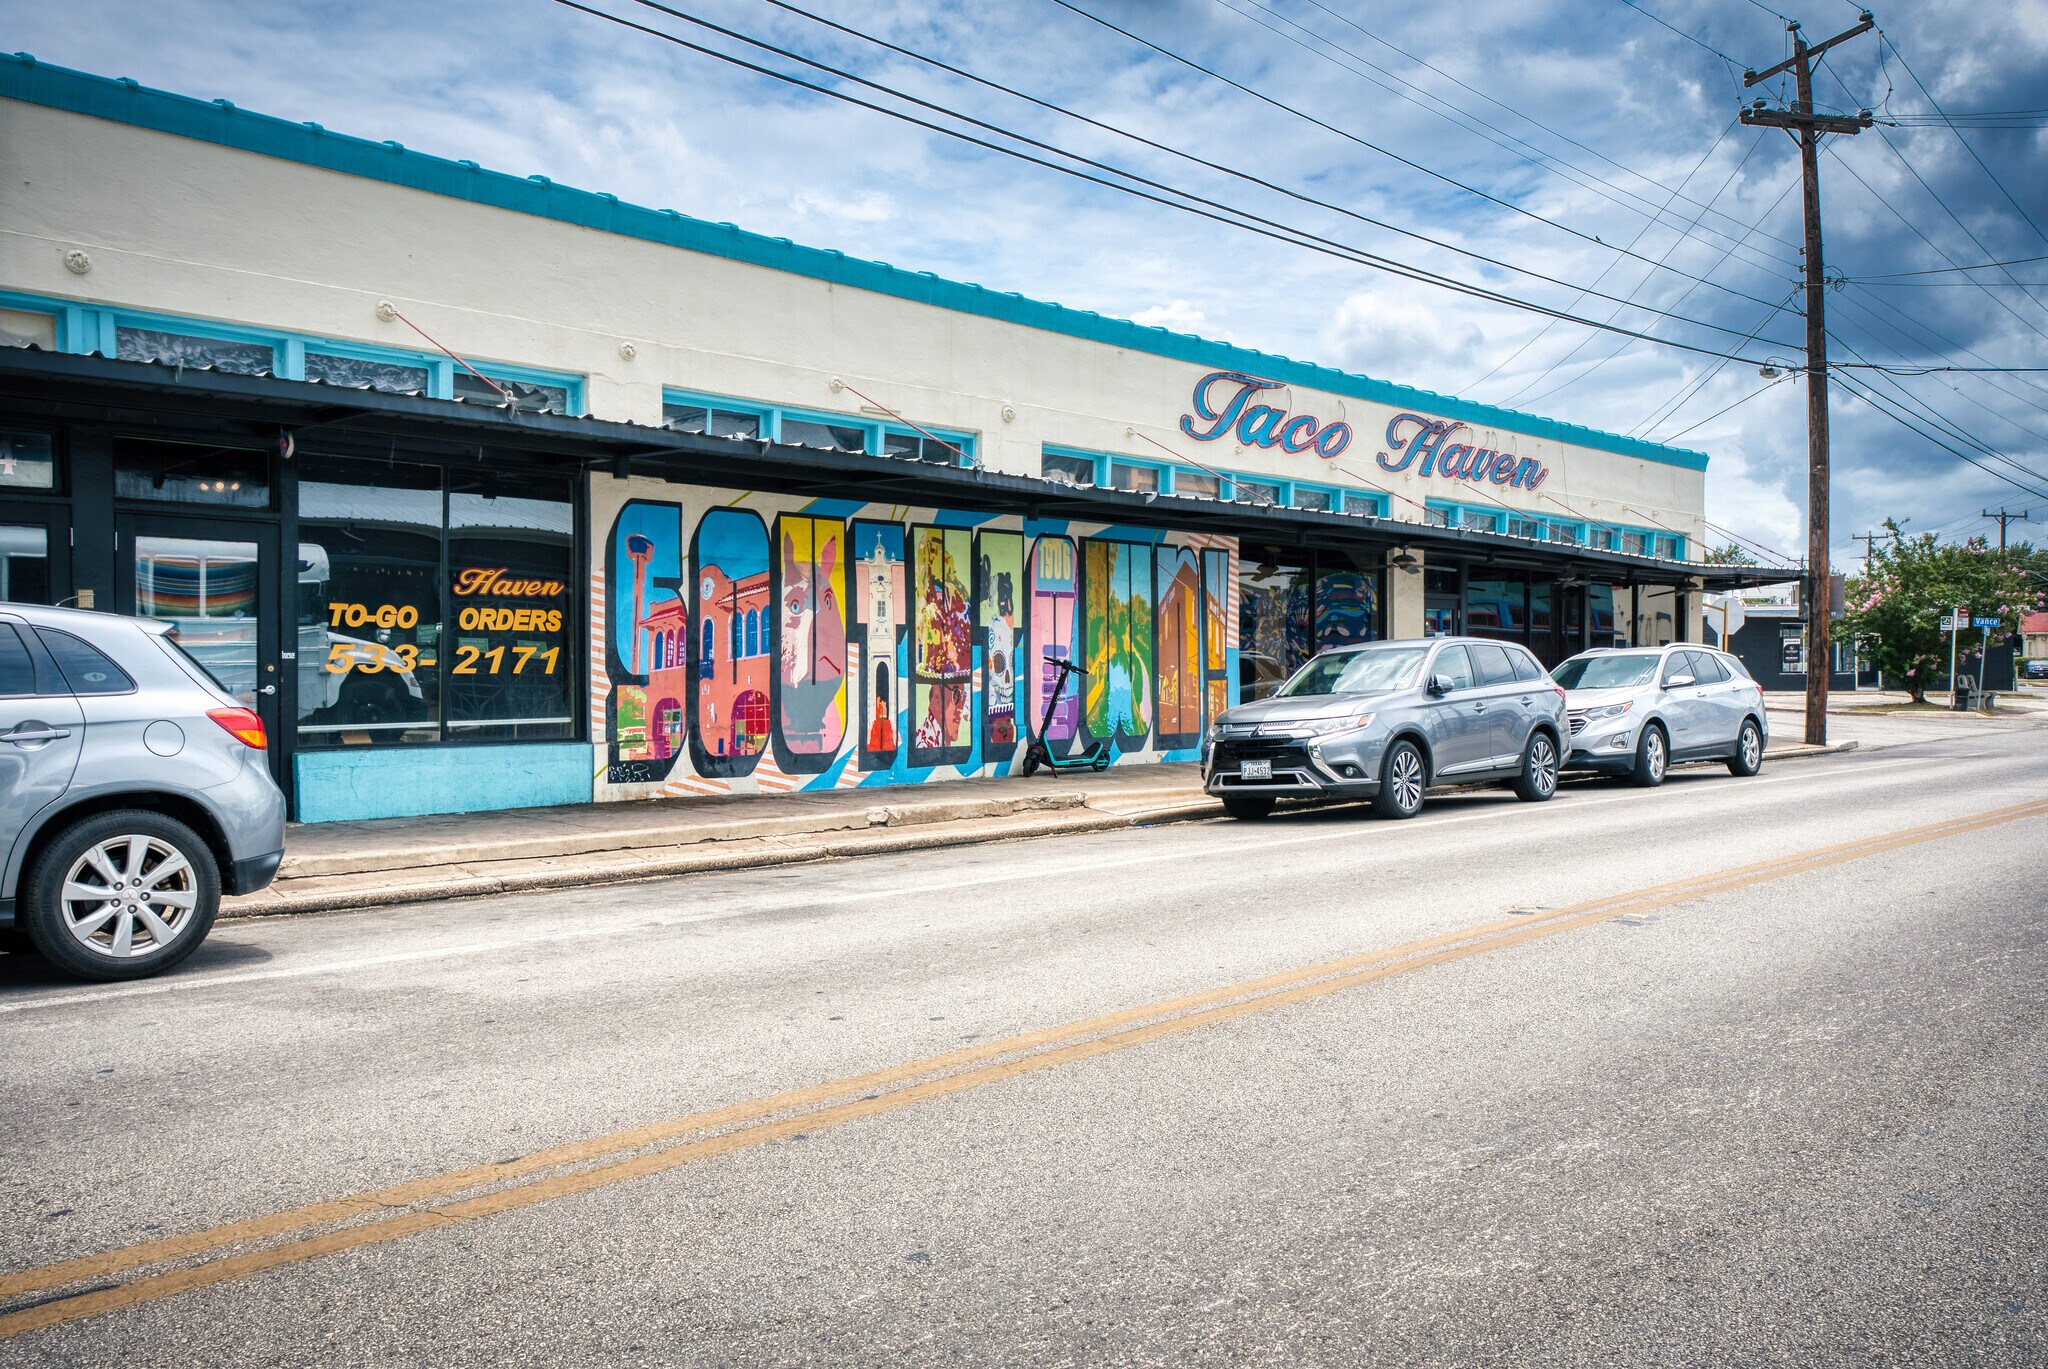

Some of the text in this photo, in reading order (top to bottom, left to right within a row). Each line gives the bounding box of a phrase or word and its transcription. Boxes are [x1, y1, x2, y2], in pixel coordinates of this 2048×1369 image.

[1180, 371, 1550, 491] Taco Haven
[453, 567, 564, 597] Haven
[329, 602, 563, 633] TO-GO ORDERS
[1975, 617, 1998, 626] Vance
[325, 643, 560, 675] 533- 2171
[1243, 767, 1271, 776] PJJ-4532
